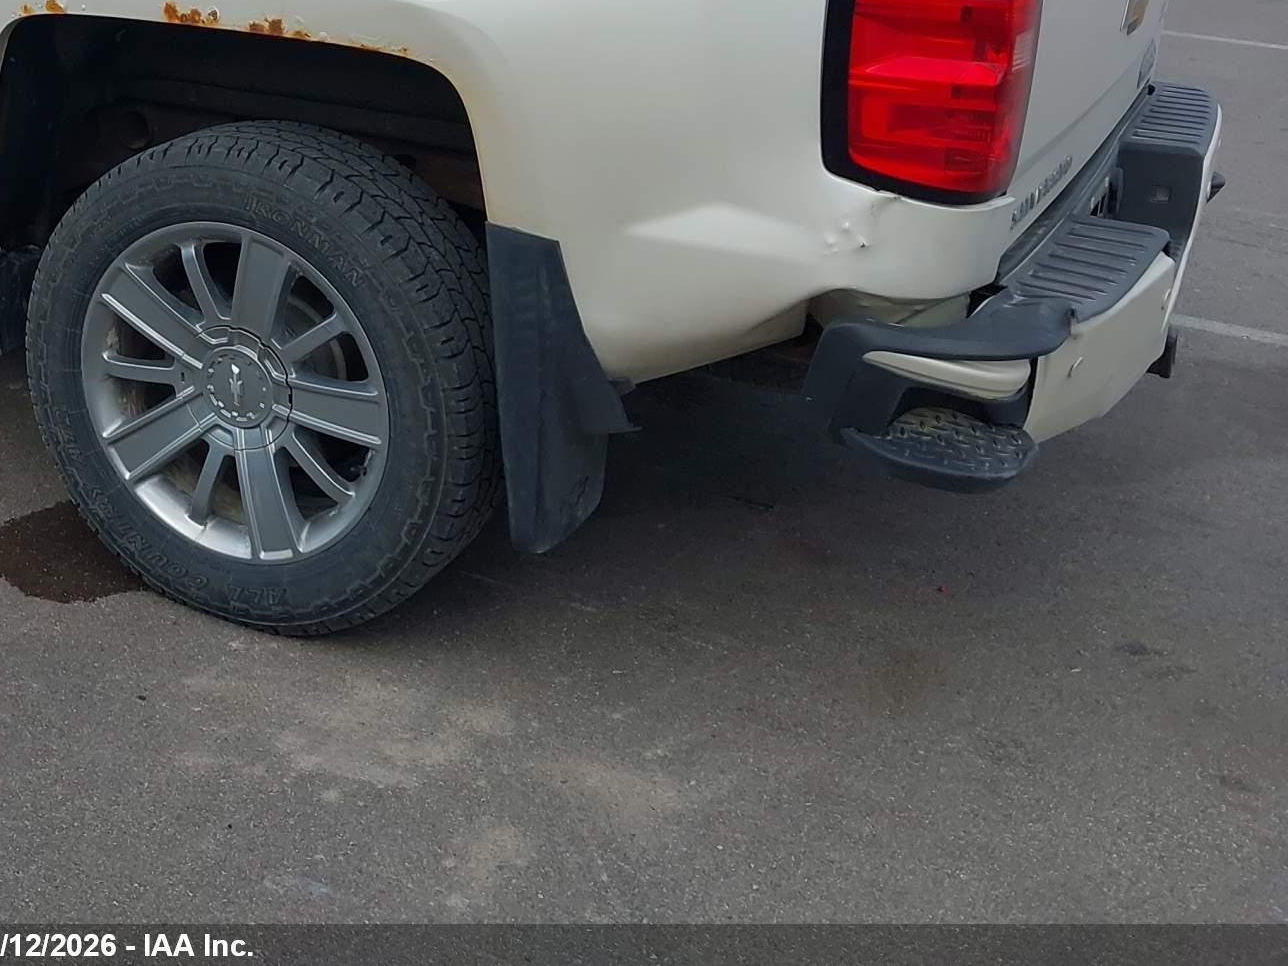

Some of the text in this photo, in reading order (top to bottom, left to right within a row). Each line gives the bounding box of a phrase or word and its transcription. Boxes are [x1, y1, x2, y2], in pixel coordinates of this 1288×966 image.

[244, 194, 366, 288] IRONMAN
[89, 484, 289, 605] ALL COUNTRY
